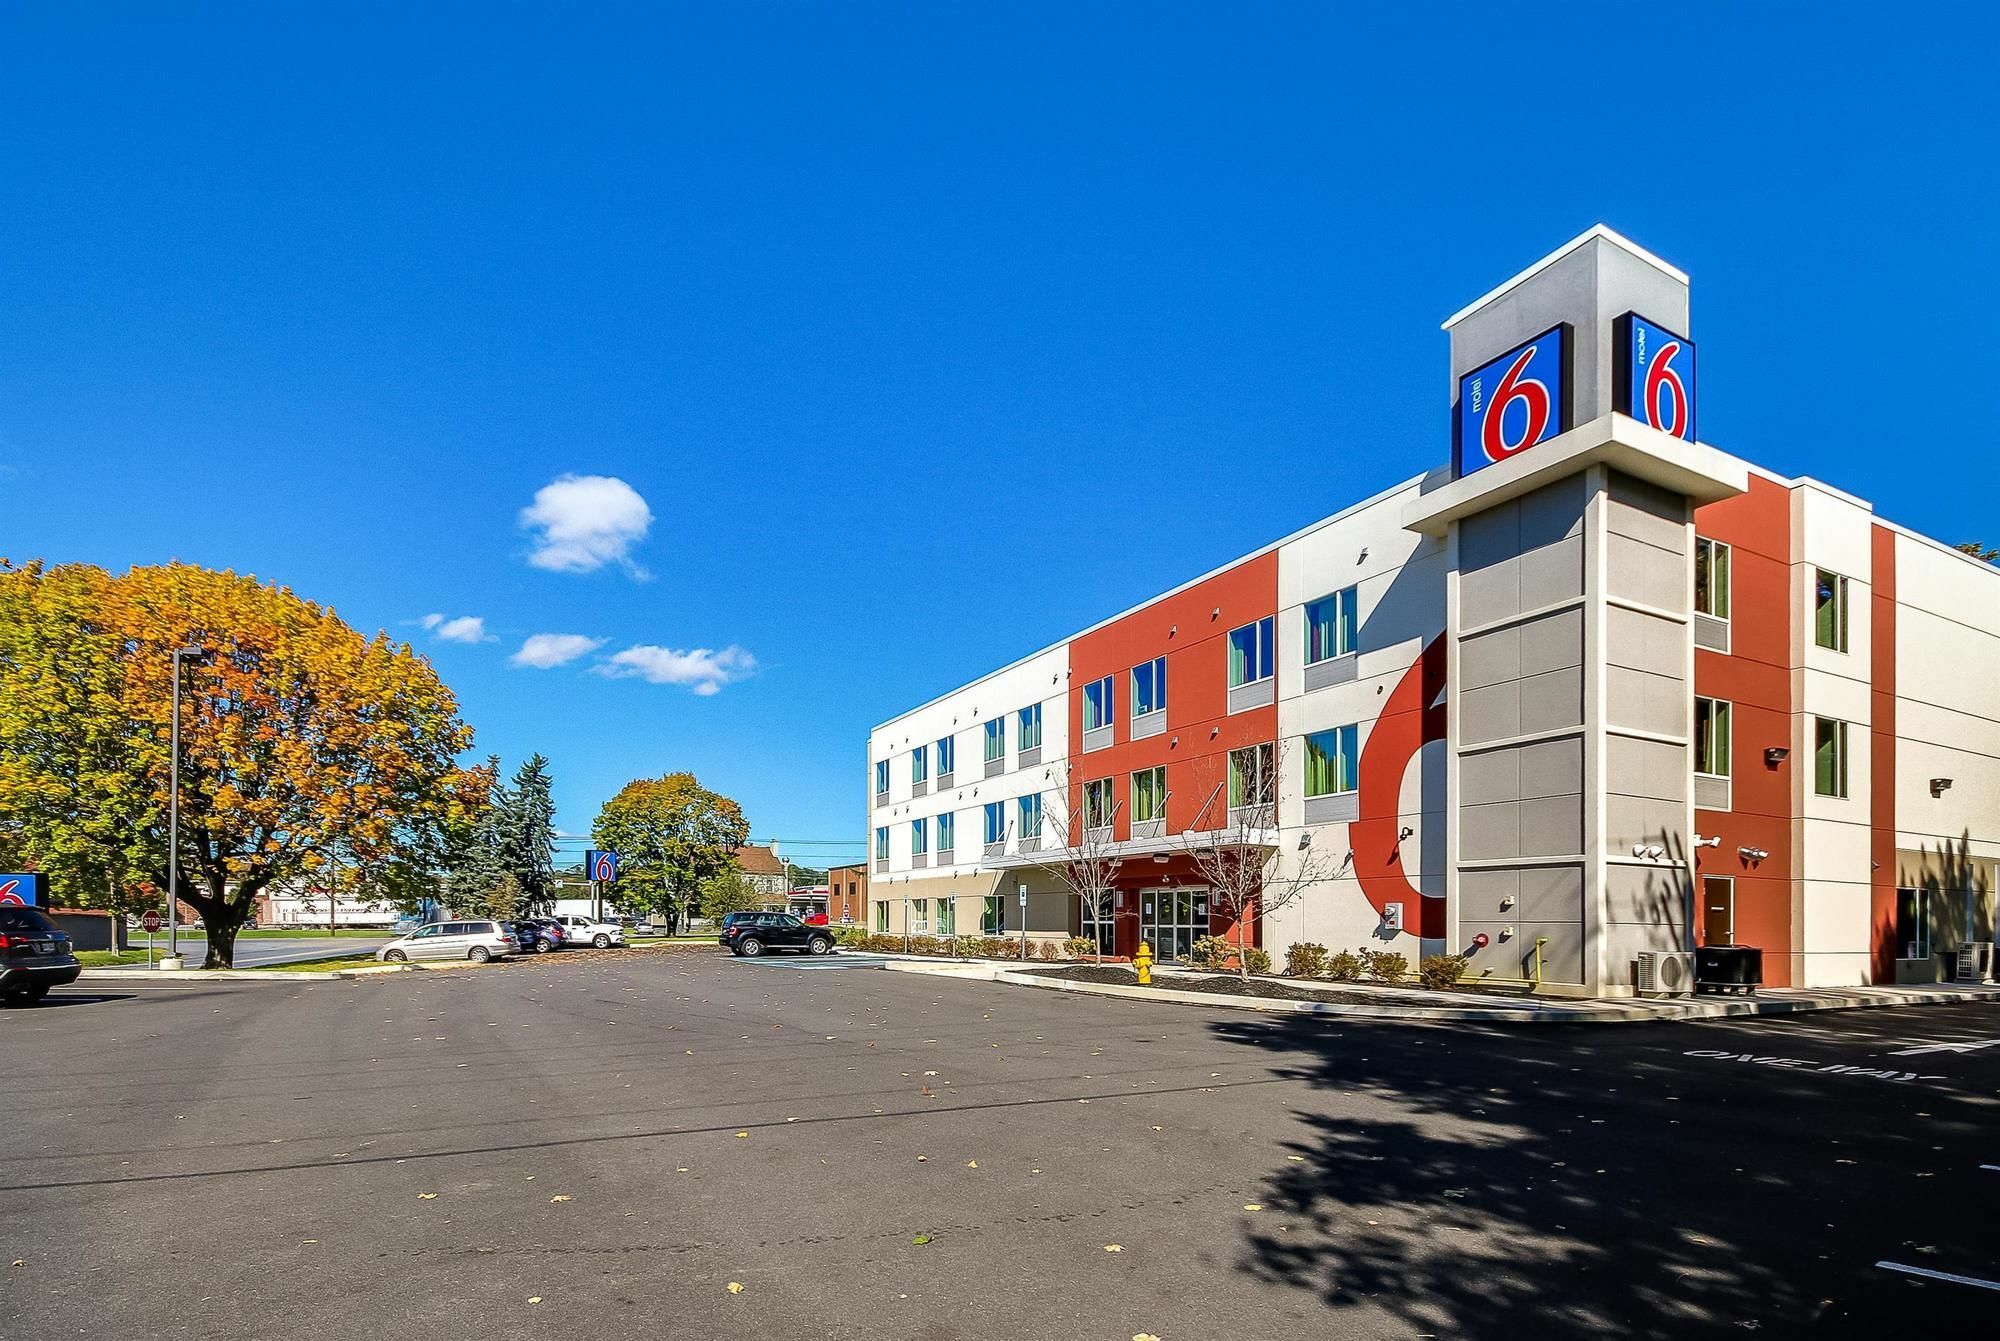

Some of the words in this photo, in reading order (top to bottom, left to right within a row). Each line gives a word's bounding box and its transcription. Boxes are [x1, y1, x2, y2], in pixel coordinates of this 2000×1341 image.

[1637, 327, 1646, 365] motel
[1643, 341, 1689, 441] 6
[1471, 377, 1482, 414] motel
[1481, 345, 1551, 463] 6
[595, 852, 614, 881] 6
[143, 917, 161, 927] STOP
[1682, 1050, 1820, 1068] ONE
